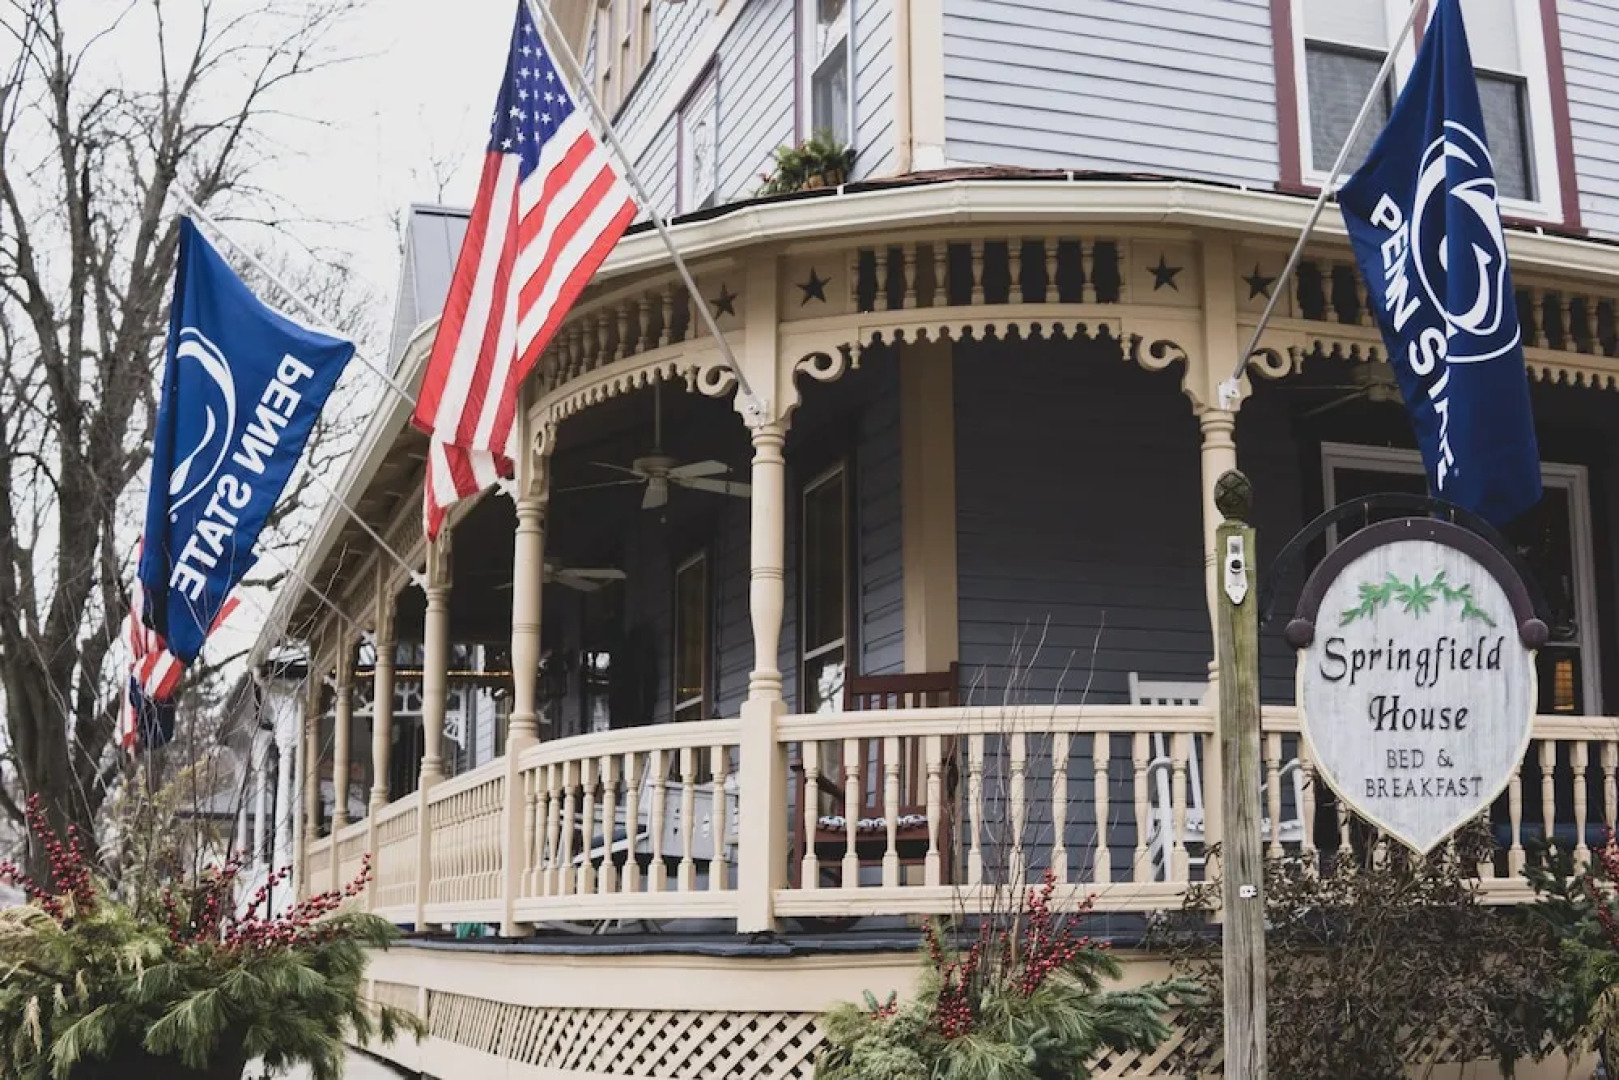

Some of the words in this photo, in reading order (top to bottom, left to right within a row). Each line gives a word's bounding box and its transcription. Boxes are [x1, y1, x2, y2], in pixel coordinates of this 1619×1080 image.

[1370, 192, 1420, 332] PENN
[1319, 635, 1505, 688] Springfield
[1368, 695, 1469, 732] House
[1386, 749, 1424, 769] BED
[1437, 748, 1454, 769] &
[1365, 776, 1483, 798] BREAKFAST
